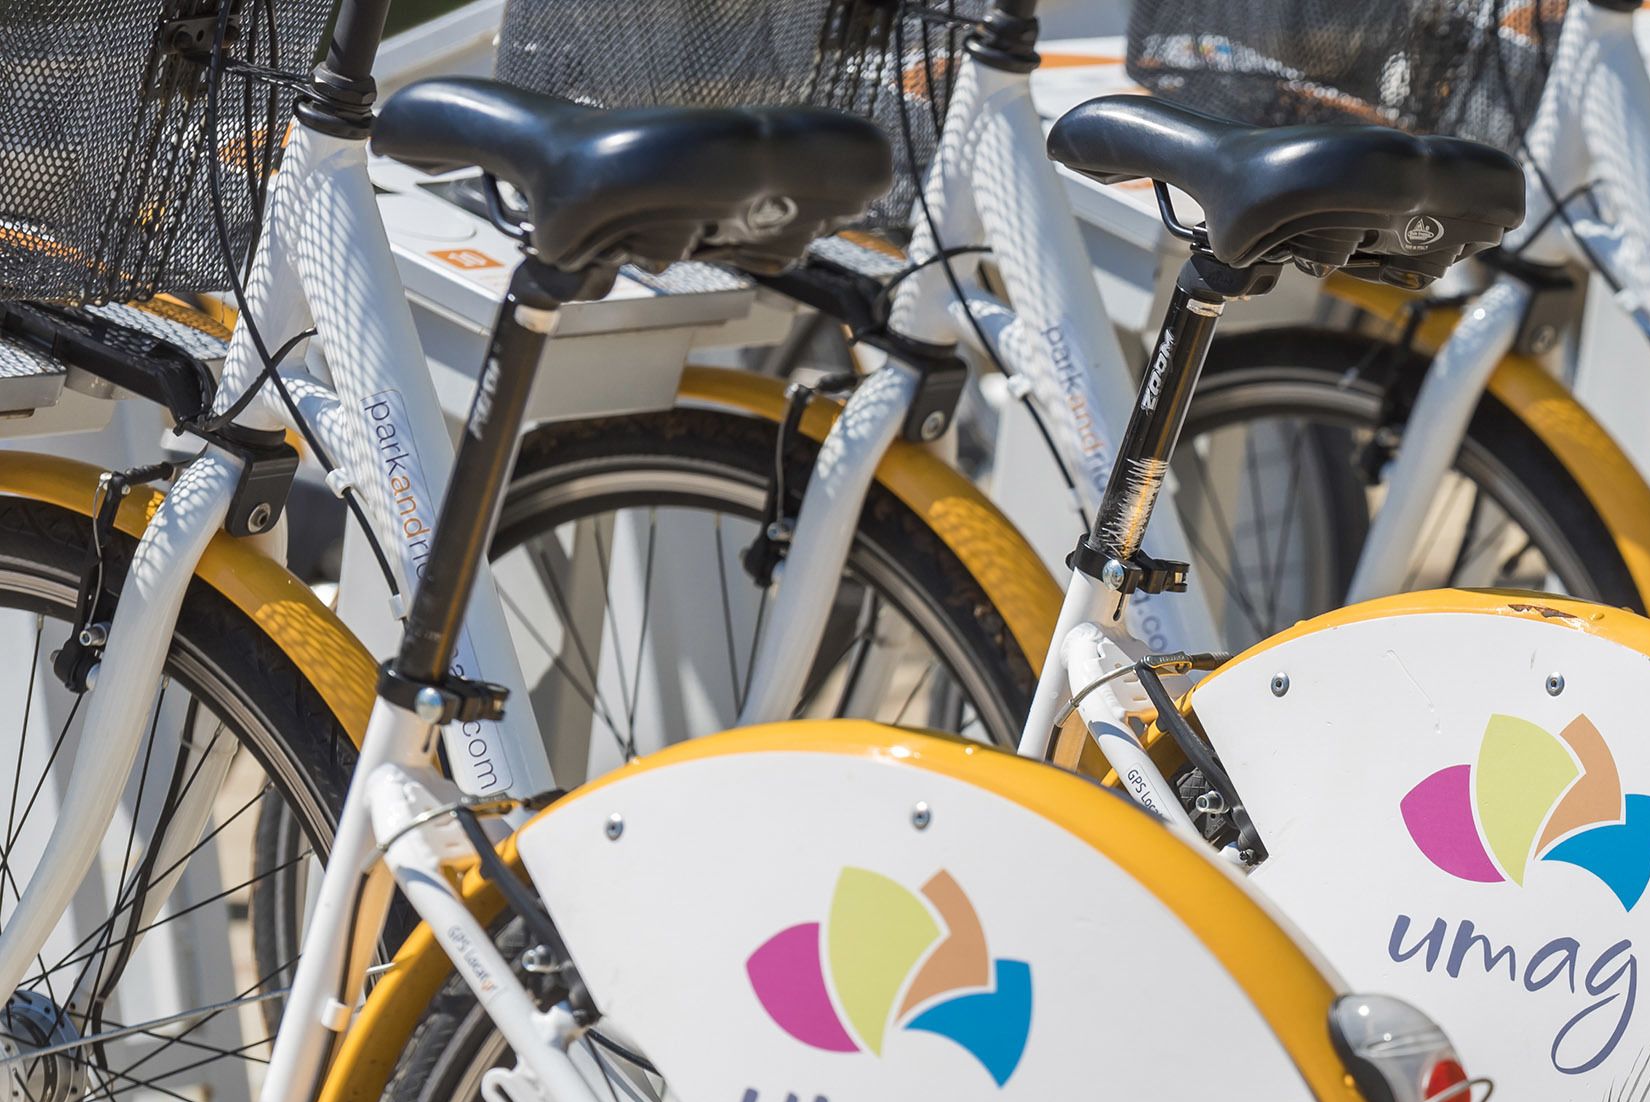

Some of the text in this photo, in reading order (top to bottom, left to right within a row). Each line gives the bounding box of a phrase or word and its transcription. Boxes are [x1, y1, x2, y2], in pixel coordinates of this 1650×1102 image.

[1141, 329, 1175, 412] ZOOM
[1127, 768, 1147, 793] GPS
[1387, 913, 1639, 1076] umag
